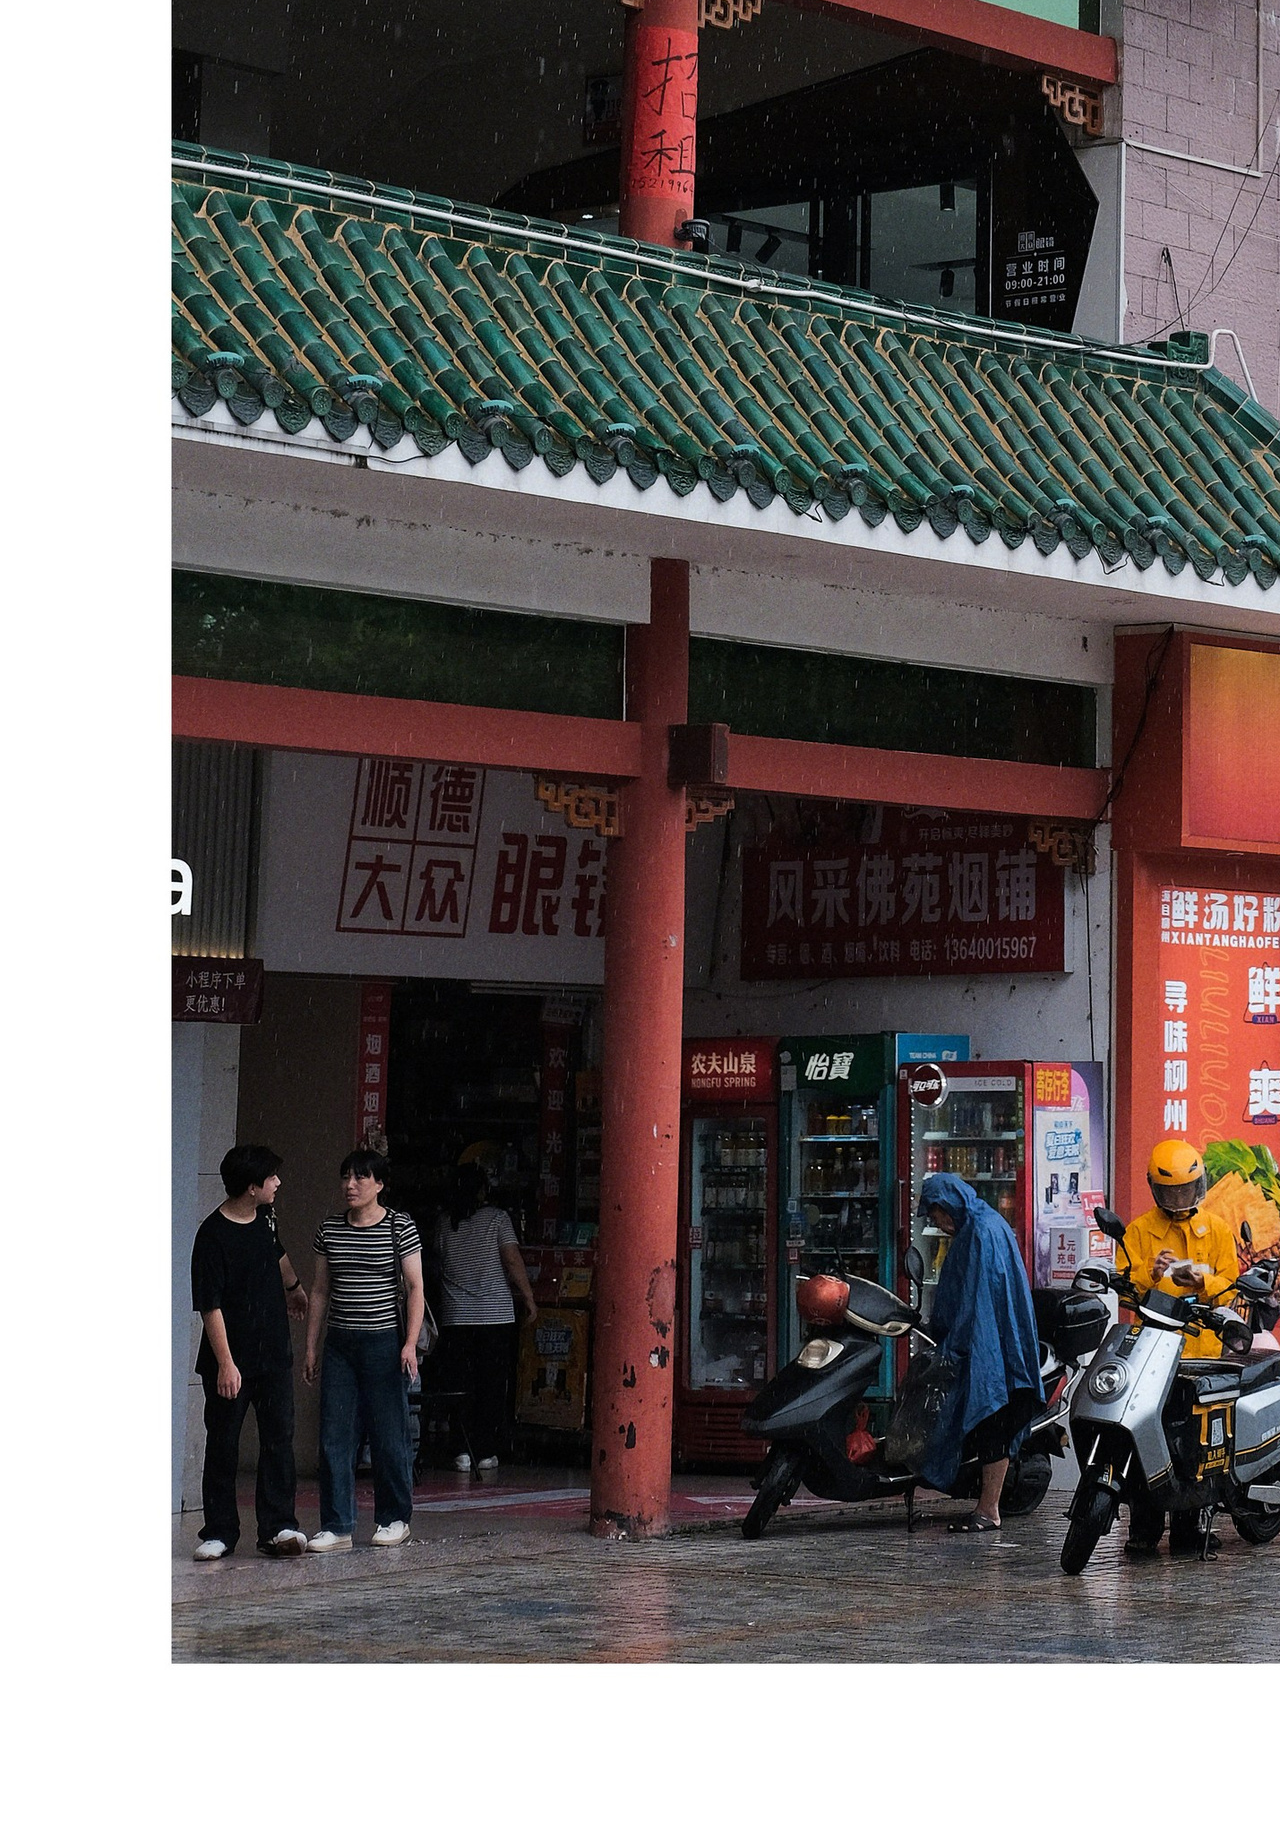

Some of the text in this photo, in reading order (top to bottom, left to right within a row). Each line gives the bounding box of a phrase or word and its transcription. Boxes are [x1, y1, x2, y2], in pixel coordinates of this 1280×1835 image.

[641, 38, 697, 177] 招租
[1006, 257, 1066, 277] 营业时间
[1005, 273, 1066, 291] 09:00-21:00
[360, 759, 476, 833] 顺德
[350, 855, 466, 924] 大众
[766, 850, 1038, 928] 风采佛苑烟铺
[185, 970, 247, 990] 小程序下单
[1256, 1015, 1274, 1023] XIAN
[691, 1051, 757, 1076] 农夫山泉
[805, 1051, 855, 1081] 怡寶
[1164, 980, 1188, 1132] 寻味柳州
[691, 1076, 757, 1089] NONGFU SPRING
[1036, 1068, 1070, 1102] 寄存行李
[1058, 1233, 1076, 1252] 1元
[1057, 1254, 1076, 1266] 充电
